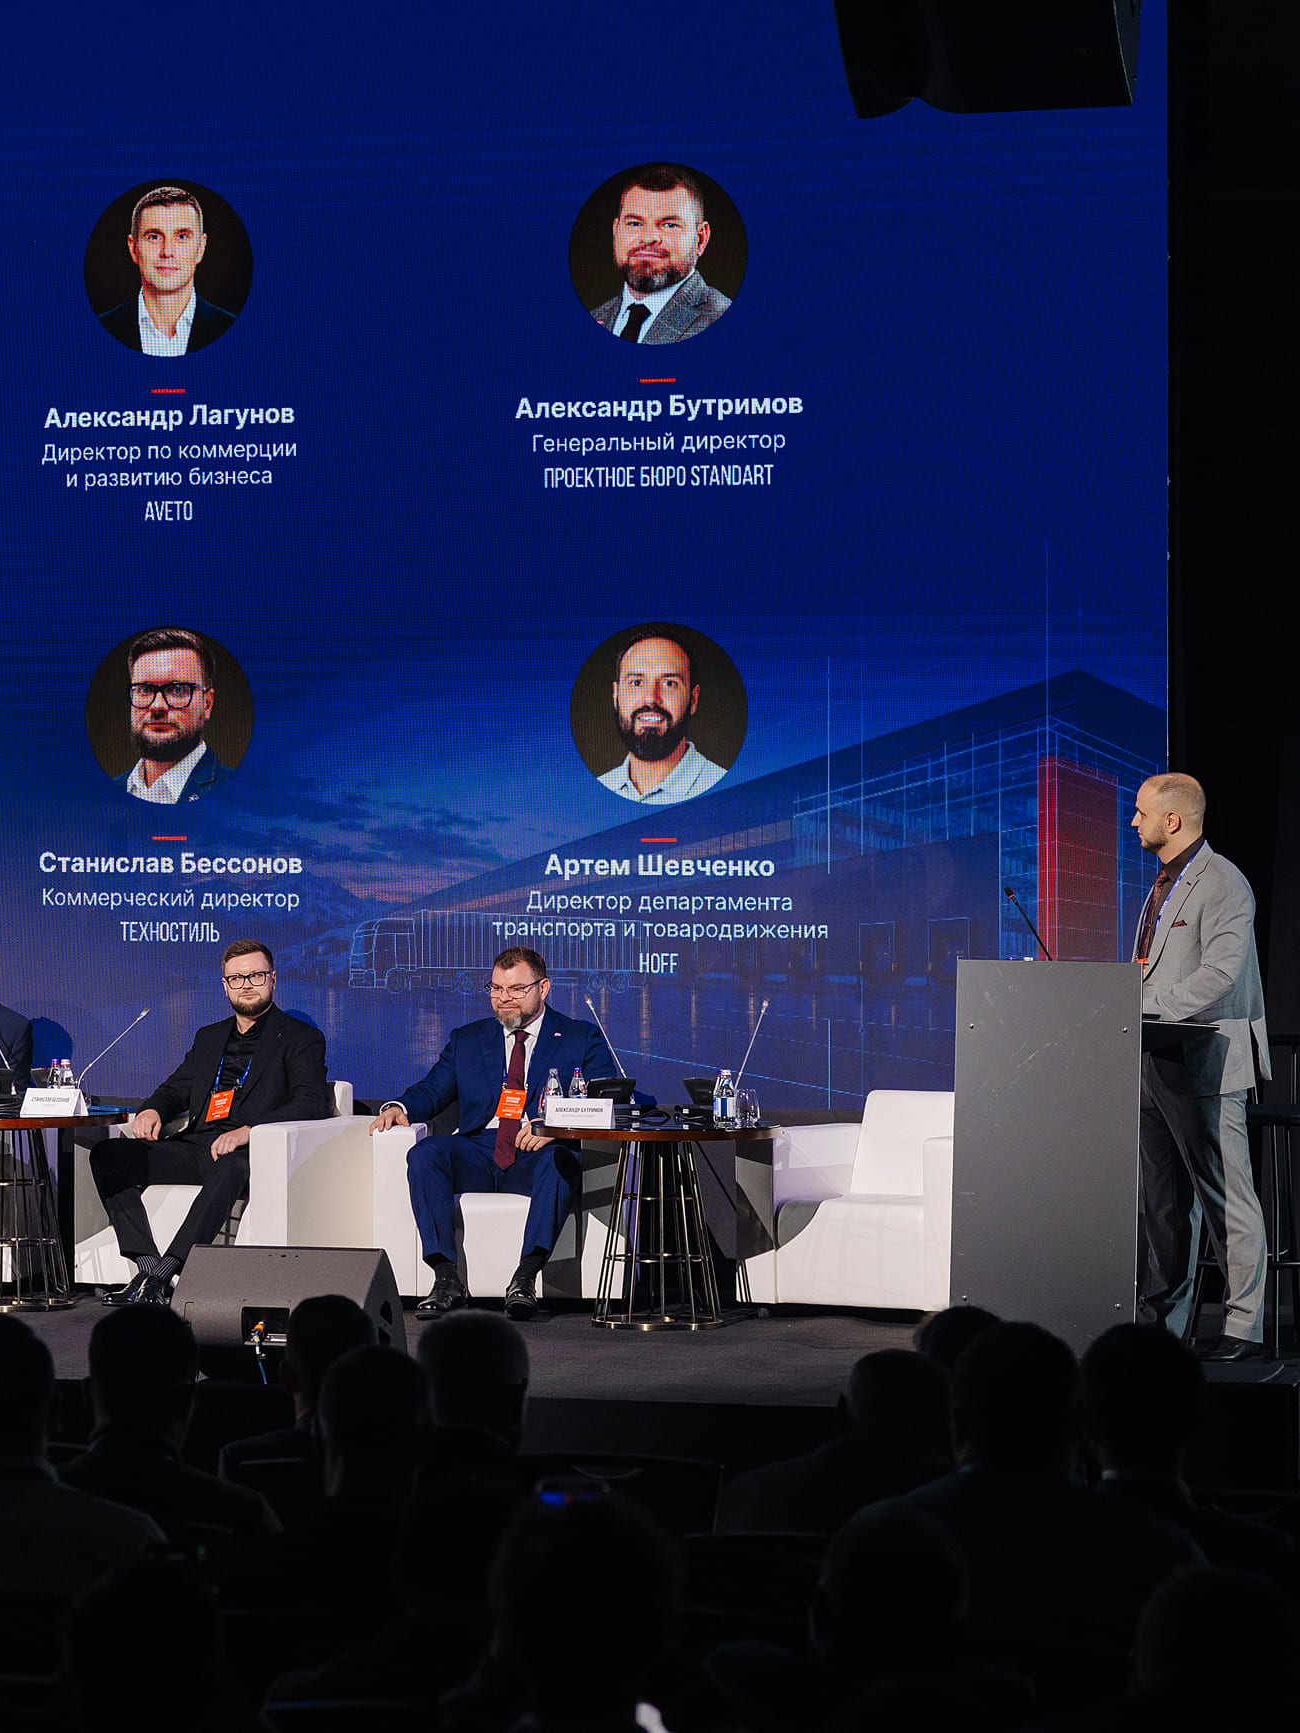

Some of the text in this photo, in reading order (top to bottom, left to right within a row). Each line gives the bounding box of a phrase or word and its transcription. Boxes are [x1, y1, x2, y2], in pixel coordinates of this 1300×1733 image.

[44, 405, 294, 431] Александр Лагунов
[516, 395, 803, 421] Александр Бутримов
[42, 443, 296, 465] Директор по коммерции
[533, 432, 785, 456] Генеральный директор
[67, 468, 272, 490] и развитию бизнеса
[545, 465, 773, 488] ПРОЕКТНОЕ БЮРО STANDART
[145, 501, 192, 521] AVETO
[40, 852, 302, 873] Станислав Бессонов
[545, 854, 774, 880] Артем Шевченко
[43, 888, 299, 911] Коммерческий директор
[526, 891, 792, 914] Директор департамента
[120, 922, 219, 942] ТЕХНОСТИЛЬ
[492, 922, 827, 941] транспорта и товародвижения
[639, 953, 678, 973] HOFF
